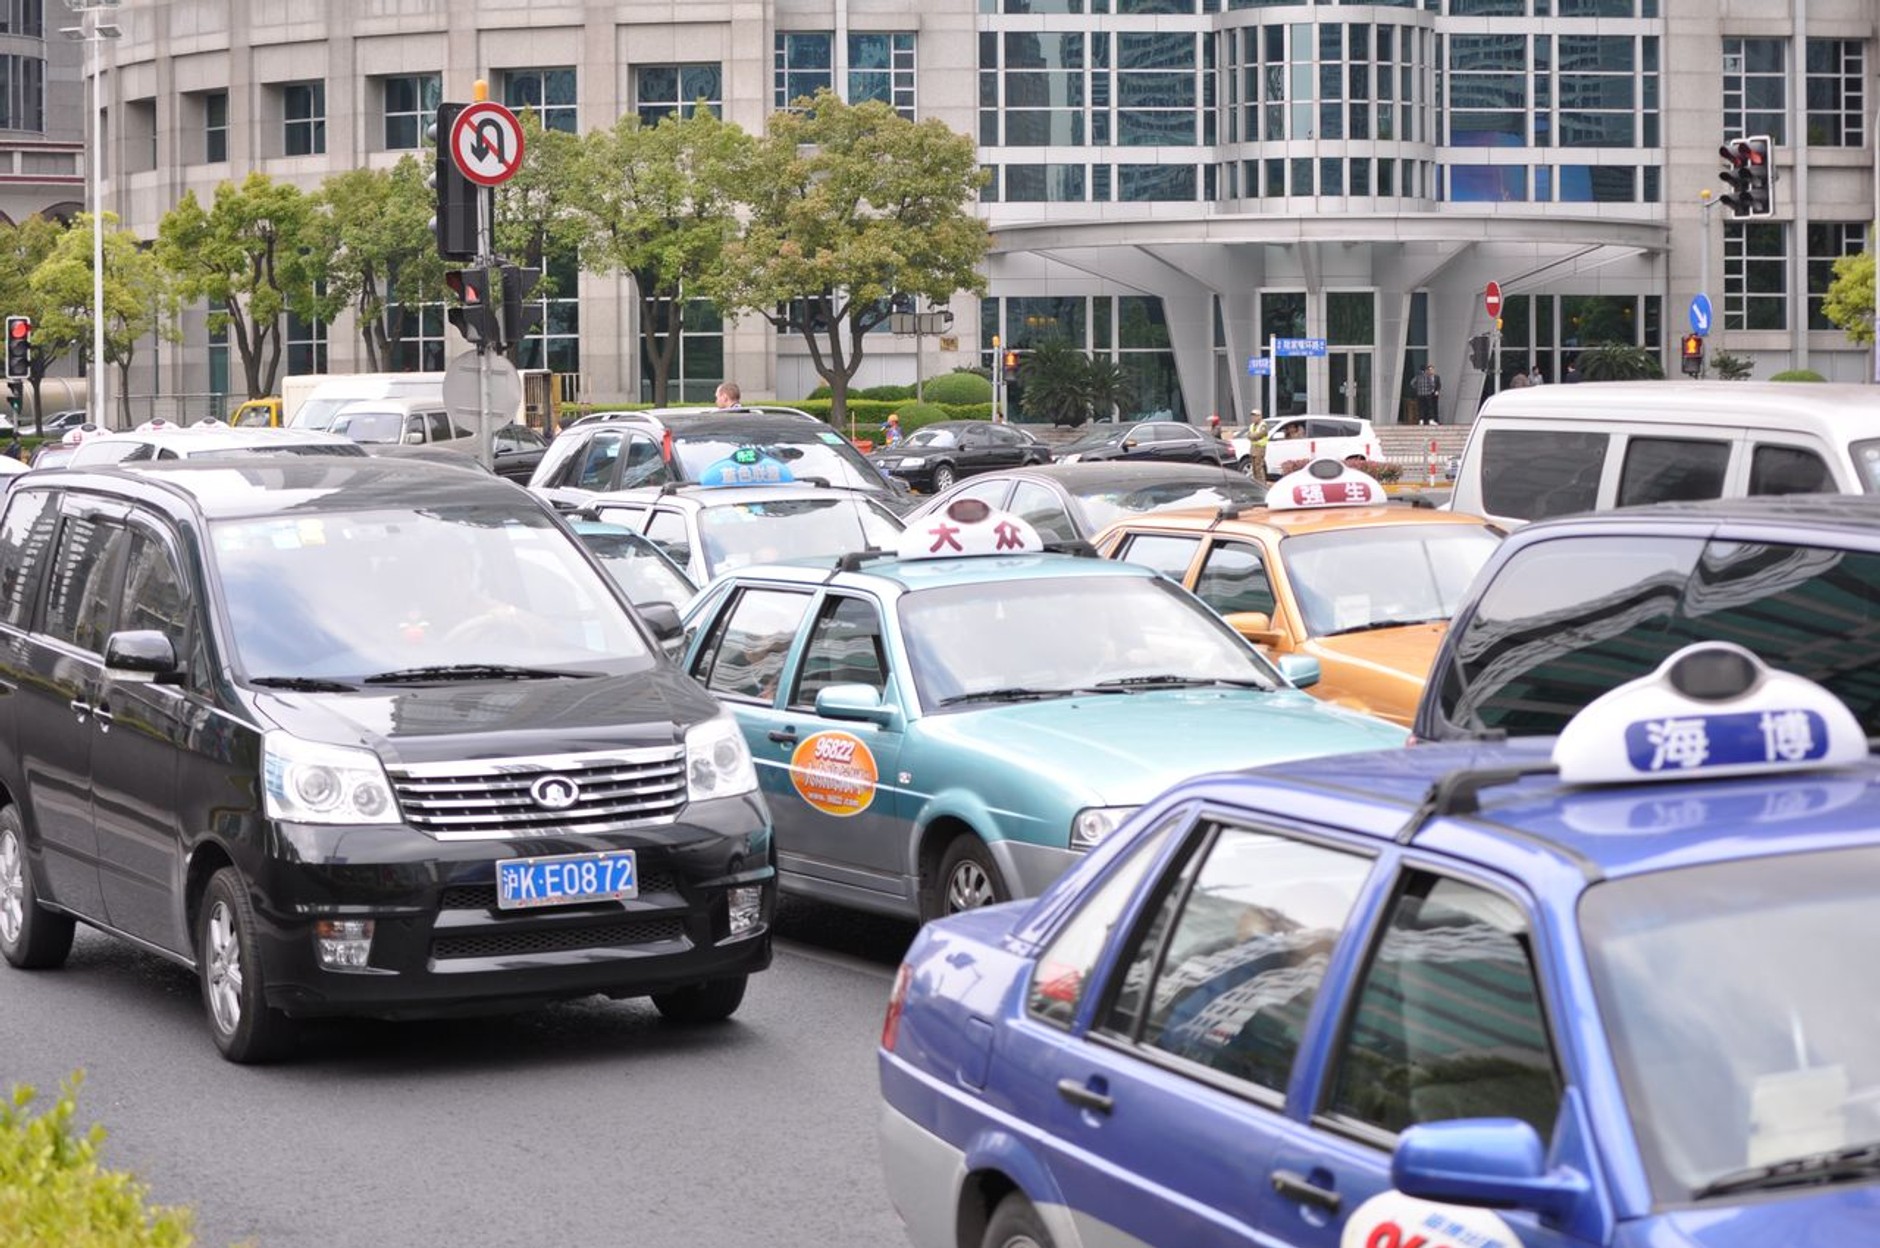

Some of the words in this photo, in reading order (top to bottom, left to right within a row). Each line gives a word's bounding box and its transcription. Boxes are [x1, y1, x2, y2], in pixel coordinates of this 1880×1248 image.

[1299, 482, 1366, 505] 强生
[928, 520, 1026, 553] 大众
[815, 736, 856, 764] 96822
[1646, 710, 1813, 770] 海博
